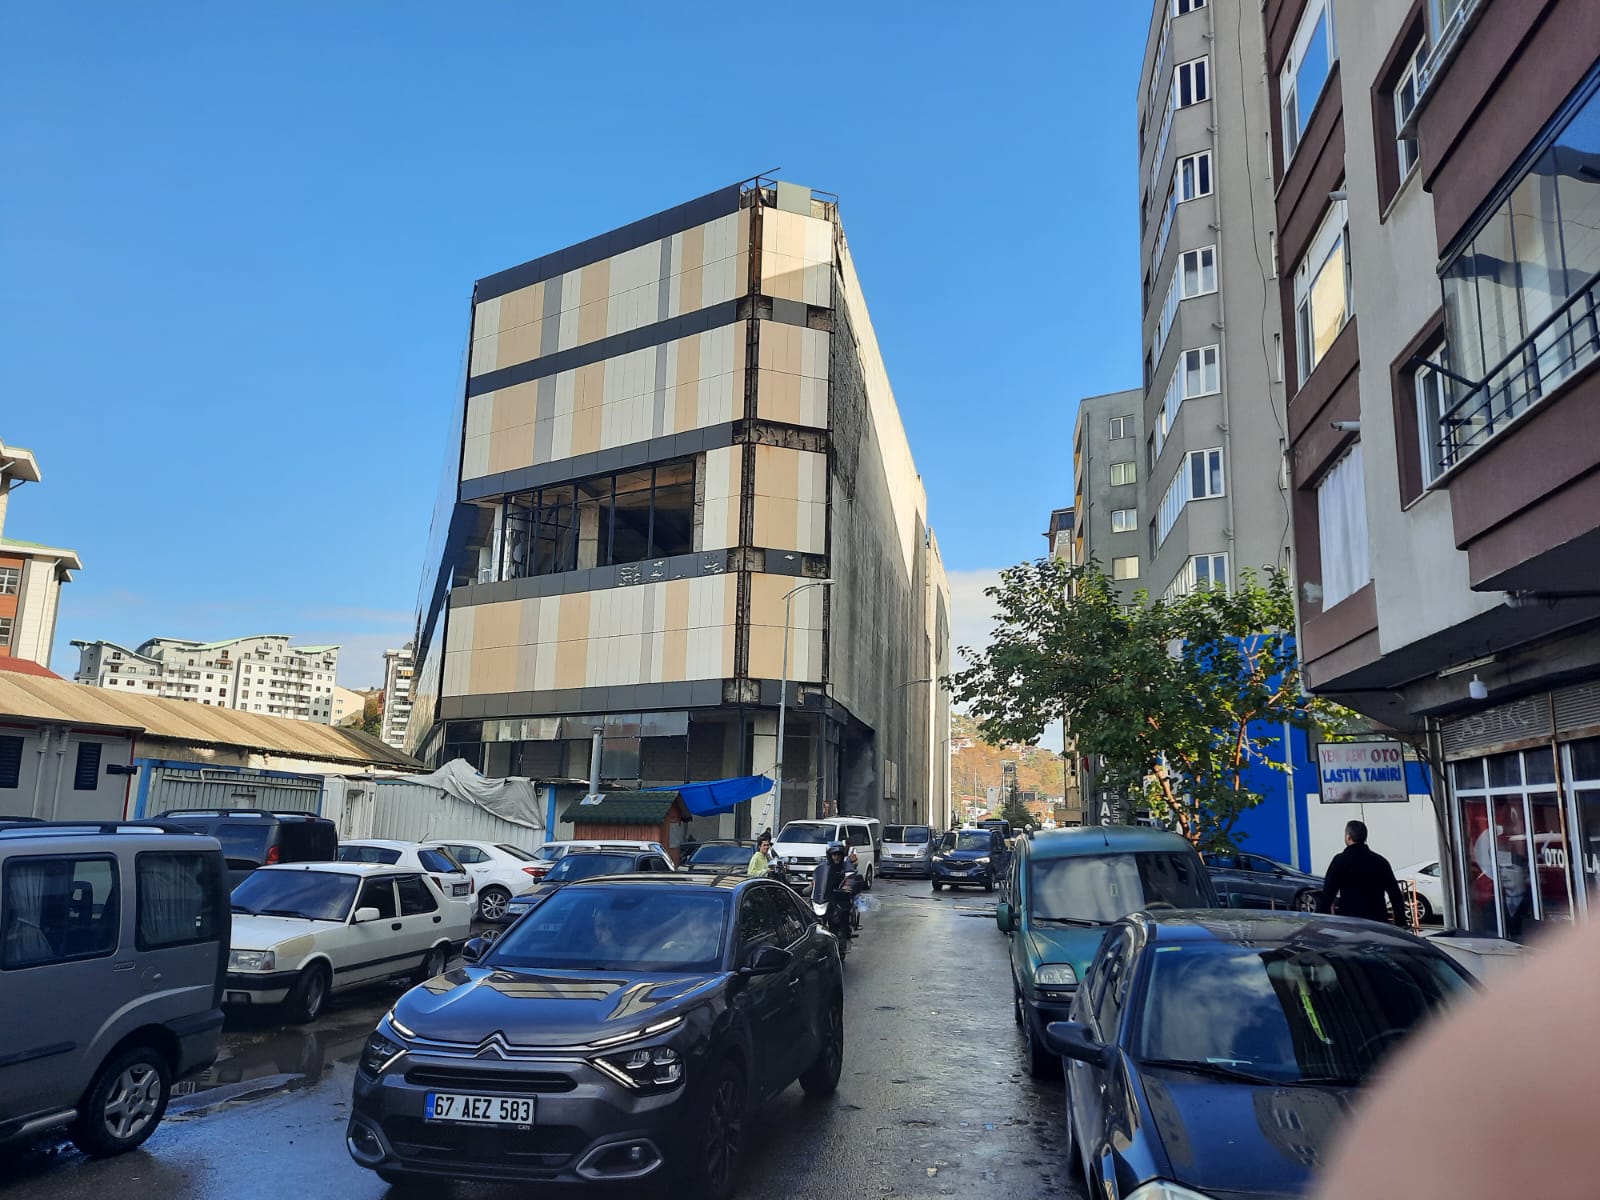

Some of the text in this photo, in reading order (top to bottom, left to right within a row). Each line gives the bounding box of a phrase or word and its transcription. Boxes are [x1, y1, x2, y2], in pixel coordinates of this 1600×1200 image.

[1371, 748, 1399, 763] OTO
[1322, 764, 1402, 783] LASTİK TAMİRİ
[435, 1096, 455, 1117] 67
[462, 1098, 493, 1119] AEZ
[500, 1100, 531, 1122] 583
